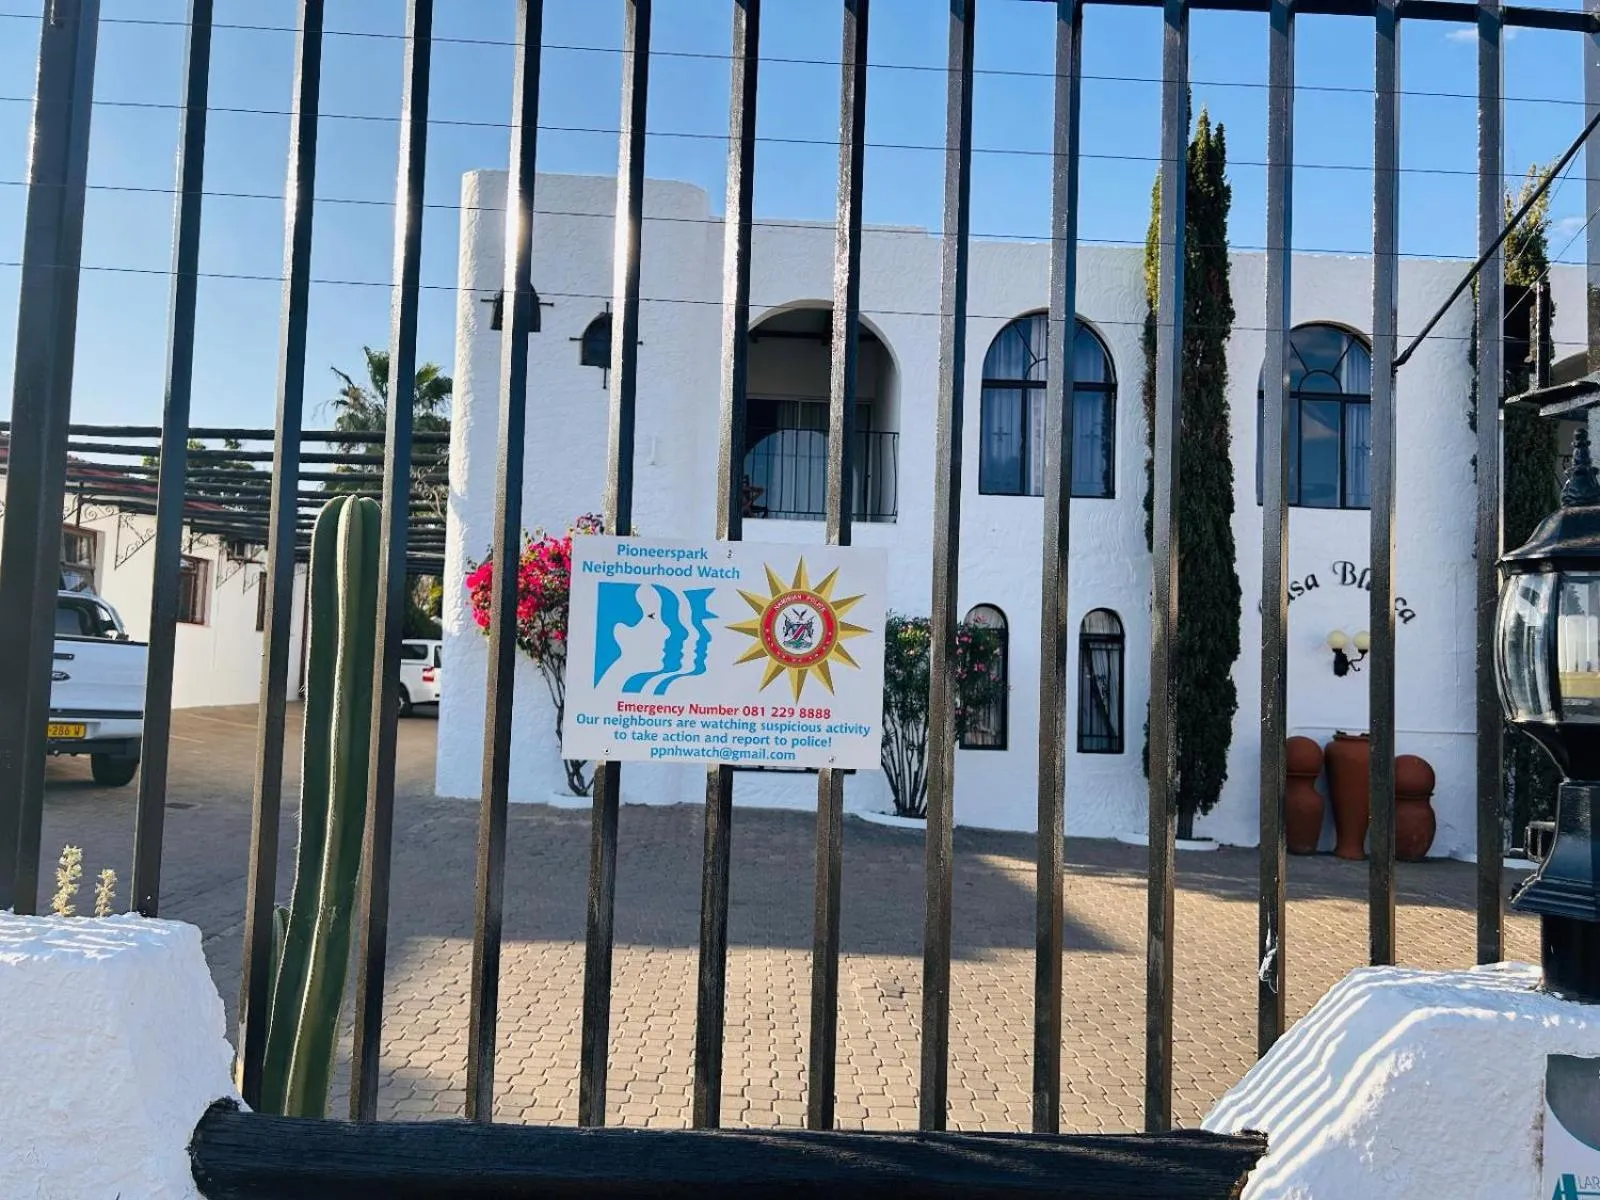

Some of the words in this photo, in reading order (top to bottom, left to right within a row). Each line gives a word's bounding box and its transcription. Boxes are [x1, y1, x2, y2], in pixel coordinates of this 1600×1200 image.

[617, 544, 708, 561] Pioneerspark
[582, 561, 693, 577] Neighbourhood
[697, 566, 740, 580] Watch
[617, 701, 684, 716] Emergency
[689, 703, 739, 716] Number
[743, 705, 765, 717] 081
[771, 706, 795, 718] 229
[799, 708, 831, 719] 8888
[576, 714, 599, 725] Our
[603, 715, 673, 729] neighbours
[677, 719, 697, 728] are
[700, 719, 757, 734] watching
[761, 720, 822, 734] suspicious
[825, 723, 870, 737] activity
[614, 730, 627, 741] to
[631, 730, 658, 741] take
[663, 732, 700, 742] action
[705, 733, 728, 743] and
[732, 735, 770, 747] report
[774, 736, 787, 746] to
[791, 736, 832, 748] police!
[650, 746, 796, 761] ppnhwatch@gmail.com
